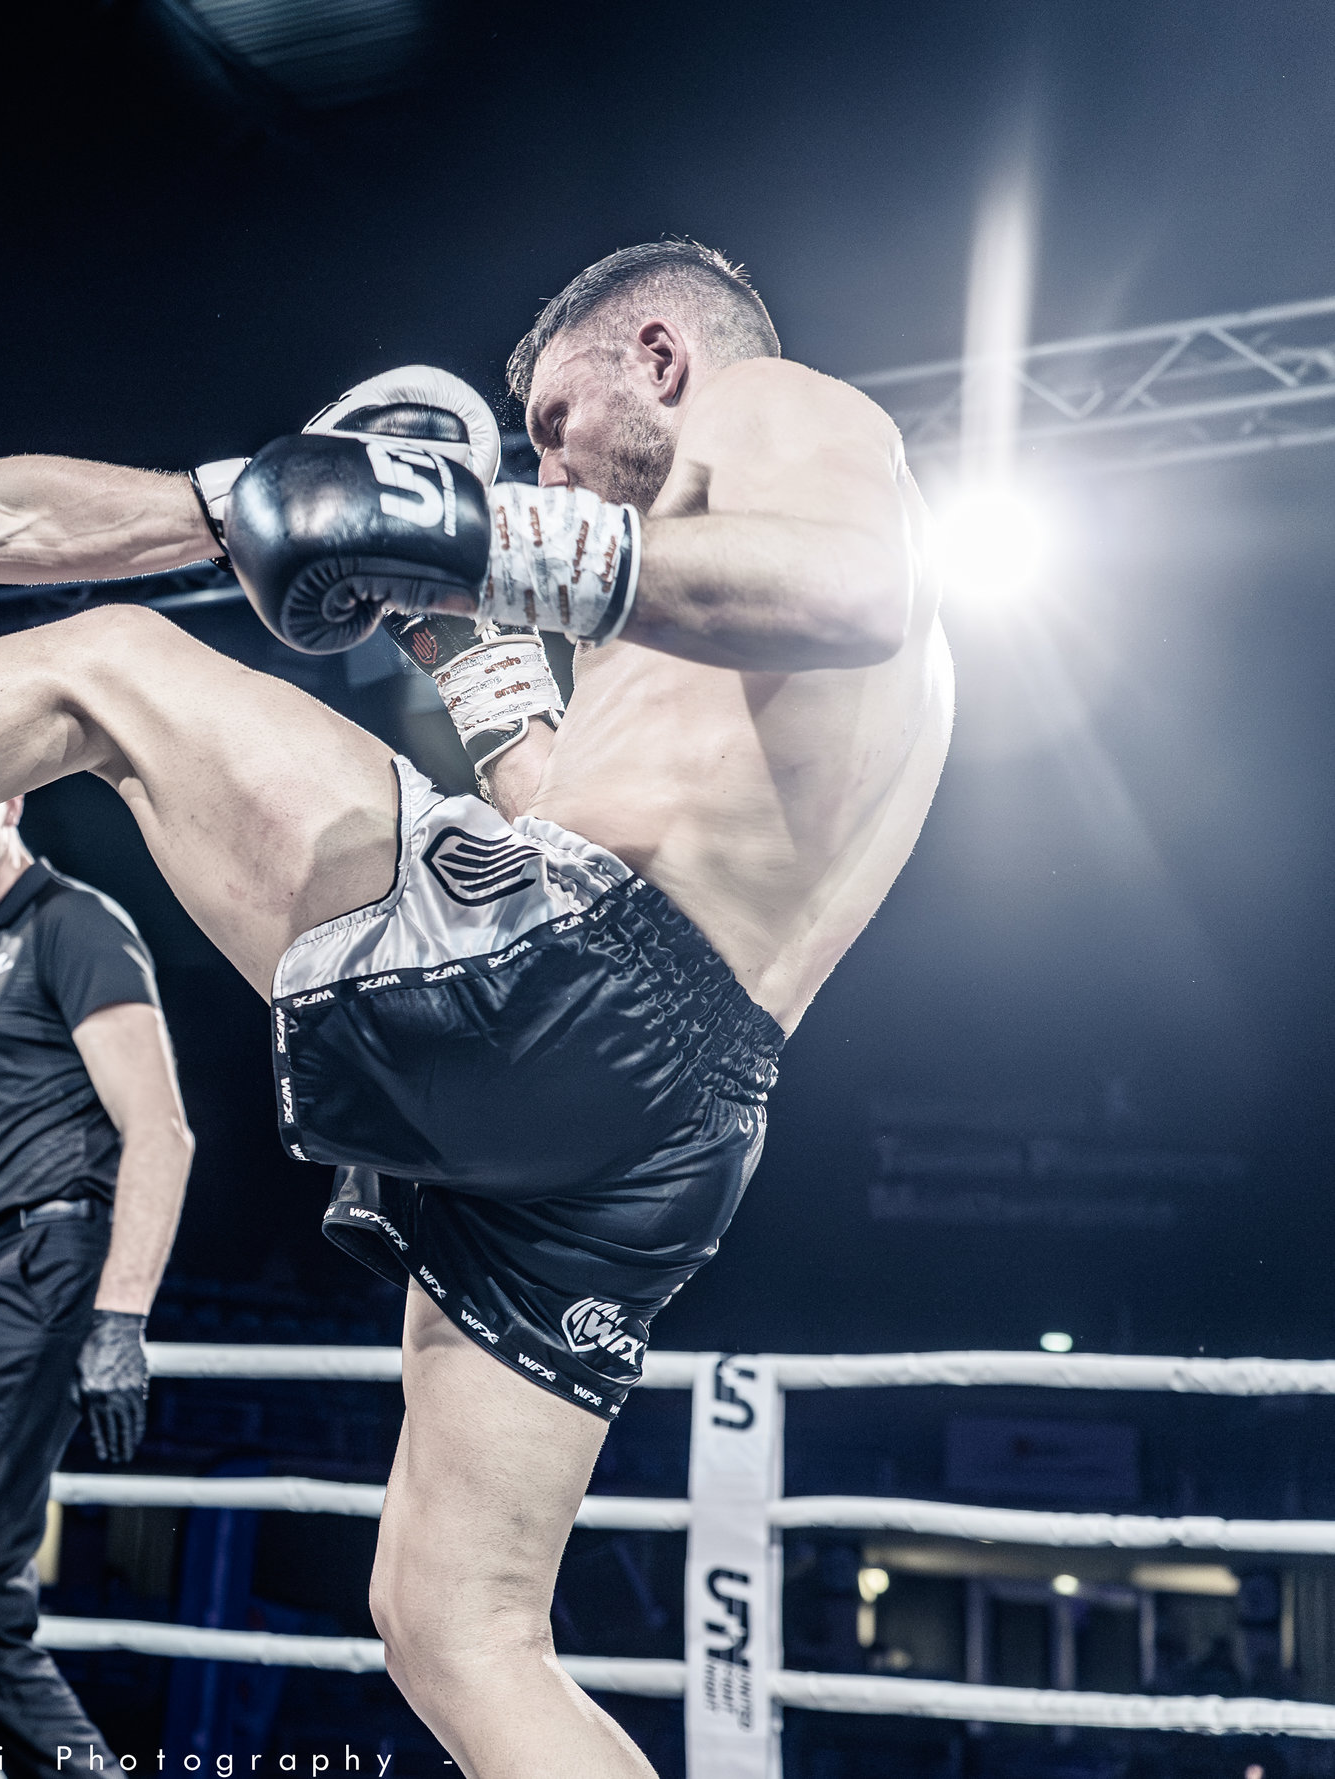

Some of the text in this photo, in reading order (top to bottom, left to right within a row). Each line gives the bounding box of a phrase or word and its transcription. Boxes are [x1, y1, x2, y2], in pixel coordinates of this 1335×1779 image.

[494, 680, 531, 699] empire
[487, 939, 533, 969] WFX
[355, 974, 402, 992] WFX
[422, 963, 466, 983] WFX
[291, 989, 336, 1009] WFX
[279, 1076, 295, 1124] WFX
[348, 1206, 385, 1225] WFX
[417, 1264, 448, 1301] WFX
[459, 1308, 501, 1345] WFX
[583, 1310, 645, 1366] WFX
[516, 1352, 558, 1382] WFX
[572, 1383, 603, 1407] WFX
